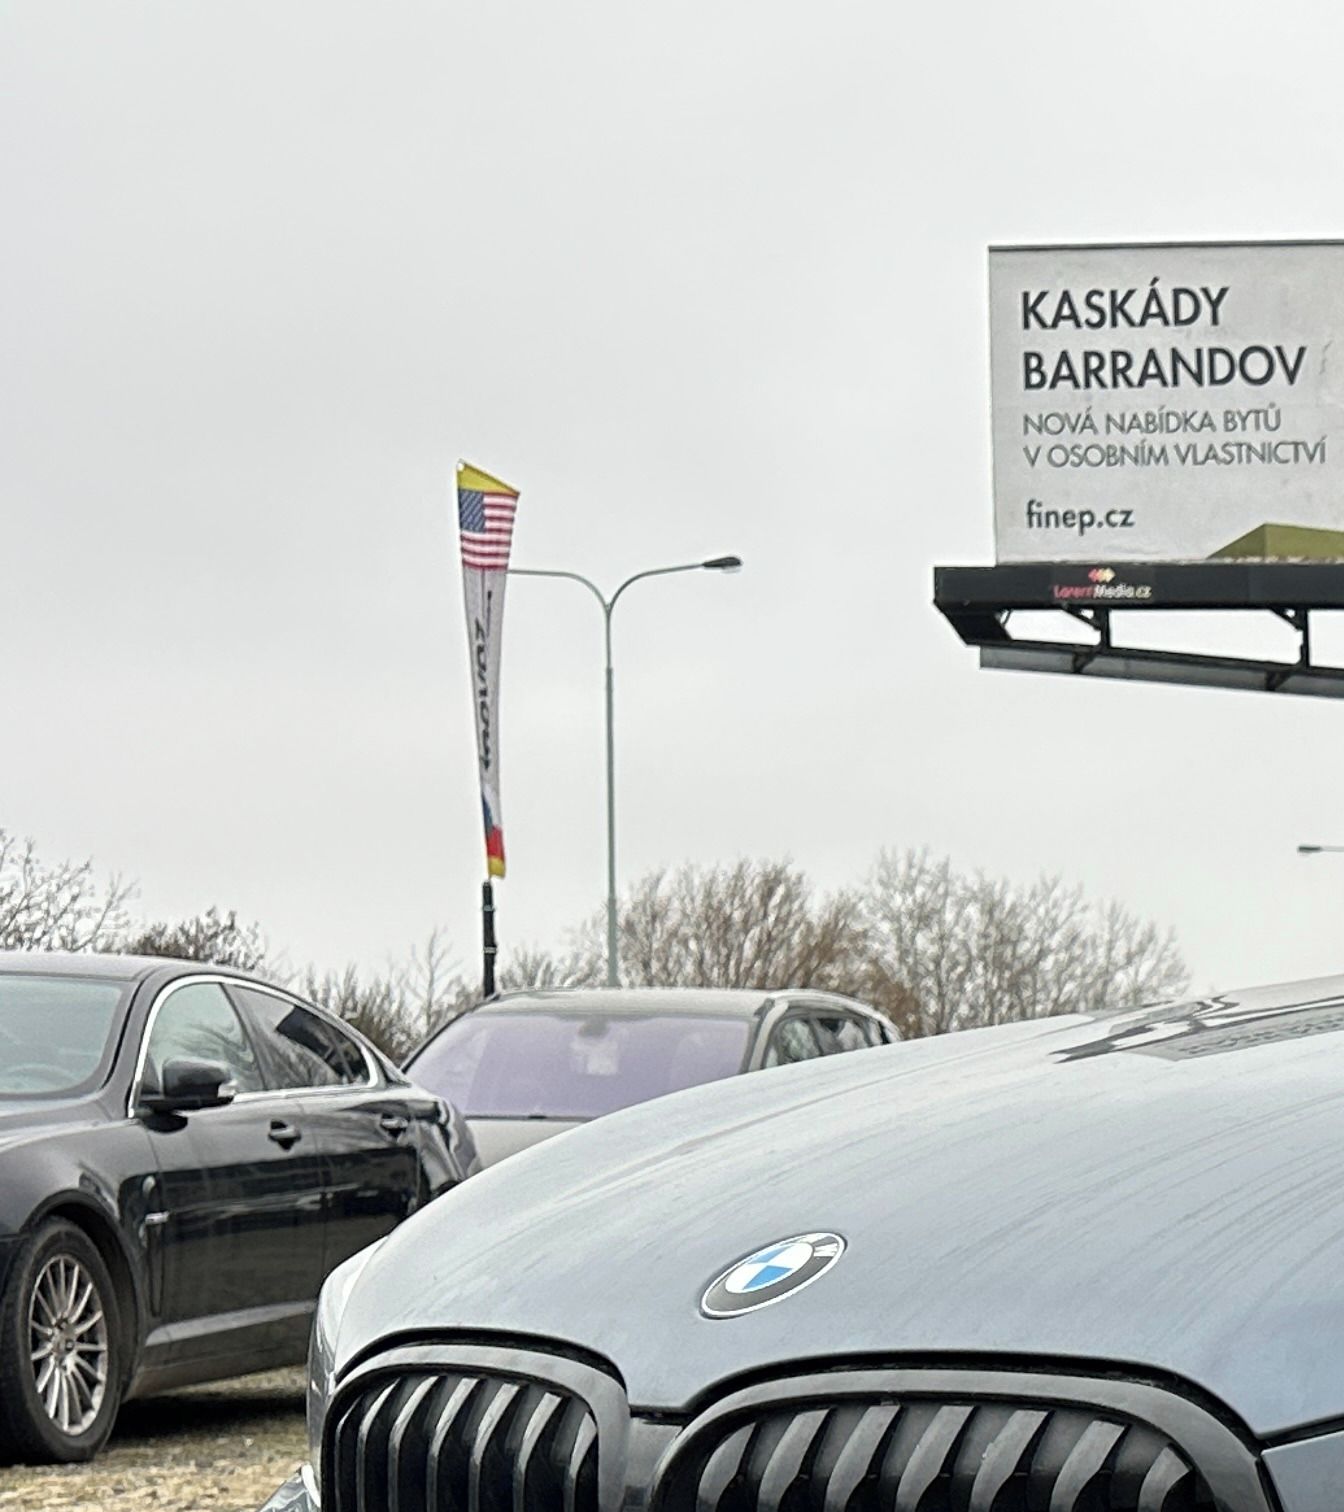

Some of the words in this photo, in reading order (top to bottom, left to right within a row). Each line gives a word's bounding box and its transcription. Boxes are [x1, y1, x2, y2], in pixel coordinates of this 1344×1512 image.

[1022, 276, 1230, 331] KASKÁDY
[1024, 345, 1307, 391] BARRANDOV
[1022, 406, 1098, 436] NOVÁ
[1105, 405, 1216, 435] NABÍDKA
[1223, 402, 1281, 432] BYTŮ
[1023, 446, 1041, 467] V
[1047, 438, 1169, 468] OSOBNÍM
[1174, 436, 1327, 466] VLASTNICTVÍ
[1026, 499, 1135, 536] finep.cz
